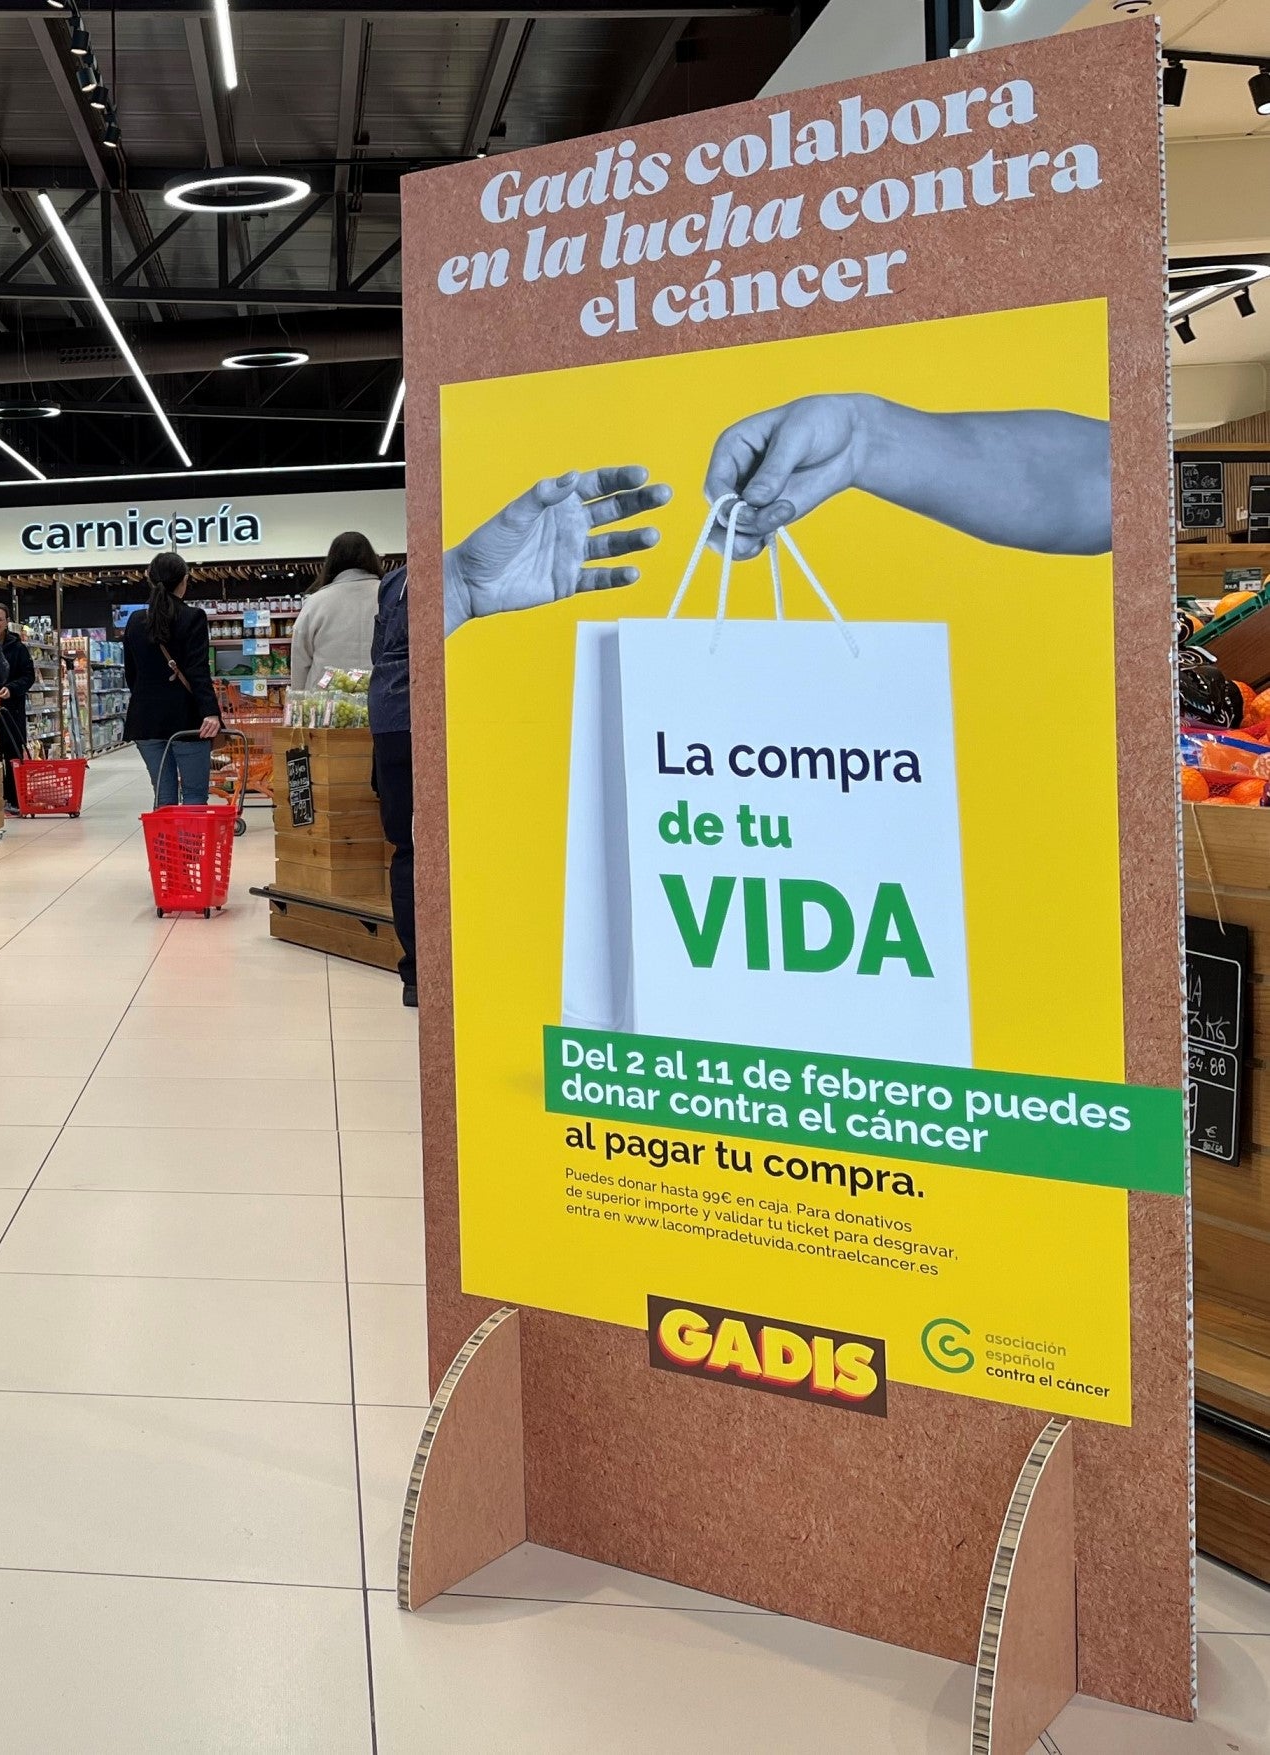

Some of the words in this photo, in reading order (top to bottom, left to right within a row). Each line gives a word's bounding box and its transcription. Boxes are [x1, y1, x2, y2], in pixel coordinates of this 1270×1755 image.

[480, 140, 670, 223] Gadis
[685, 78, 1037, 185] colabora
[438, 248, 509, 295] en
[523, 226, 587, 282] la
[600, 191, 804, 269] lucha
[820, 144, 1102, 230] contra
[580, 277, 638, 337] el
[652, 249, 907, 326] cáncer
[21, 505, 260, 552] carnicería
[657, 732, 713, 775] La
[729, 745, 921, 792] compra
[659, 801, 723, 845] de
[737, 805, 791, 848] tu
[659, 874, 934, 978] VIDA
[560, 1082, 660, 1110] donar
[670, 1093, 788, 1127] contra
[799, 1103, 836, 1133] el
[846, 1110, 988, 1152] cáncer
[562, 1040, 617, 1072] Del
[627, 1052, 644, 1075] 2
[655, 1051, 687, 1080] al
[697, 1060, 733, 1085] 11
[744, 1060, 791, 1091] de
[802, 1065, 952, 1110] febrero
[966, 1091, 1130, 1131] puedes
[566, 1122, 595, 1150] al
[606, 1133, 705, 1167] pagar
[715, 1141, 752, 1172] tu
[764, 1155, 923, 1197] compra.
[566, 1168, 614, 1185] Puedes
[618, 1176, 657, 1192] donar
[661, 1182, 698, 1199] hasta
[702, 1191, 731, 1204] 99€
[736, 1197, 754, 1207] en
[759, 1199, 792, 1214] caja.
[797, 1203, 830, 1220] Para
[835, 1209, 912, 1232] donativos
[566, 1185, 582, 1198] de
[587, 1191, 641, 1207] superior
[645, 1197, 698, 1217] importe
[702, 1209, 710, 1221] y
[715, 1211, 764, 1227] validar
[768, 1217, 782, 1230] tu
[787, 1220, 829, 1238] ticket
[834, 1231, 868, 1245] para
[873, 1234, 957, 1260] desgravar,
[566, 1205, 600, 1218] entra
[604, 1211, 620, 1221] en
[624, 1213, 938, 1275] www.lacompradetuvida.contraelcancer.es
[658, 1308, 881, 1401] GADIS
[985, 1334, 1066, 1356] asociación
[986, 1351, 1054, 1370] española
[987, 1367, 1034, 1383] contra
[1040, 1375, 1051, 1386] el
[1057, 1380, 1109, 1396] cáncer
